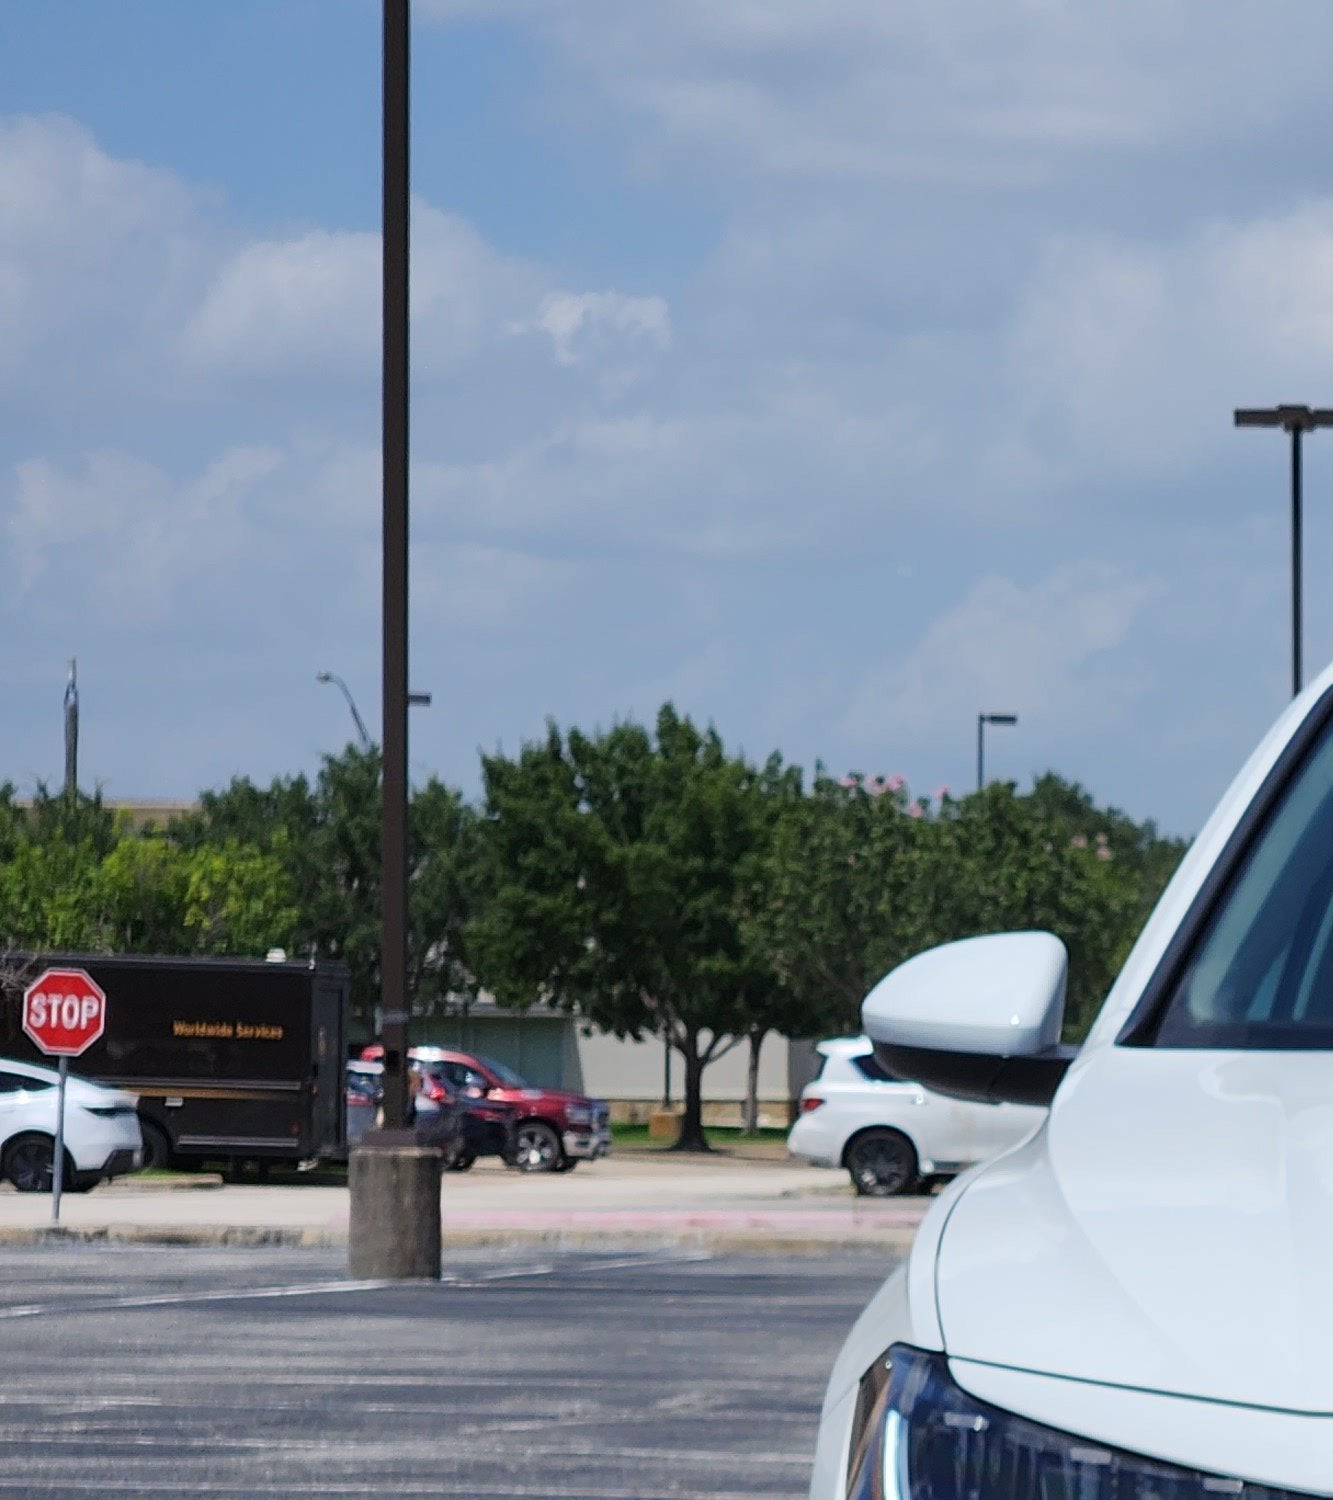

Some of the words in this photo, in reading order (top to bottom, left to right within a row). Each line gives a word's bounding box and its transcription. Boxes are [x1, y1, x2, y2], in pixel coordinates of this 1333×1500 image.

[29, 993, 99, 1030] STOP
[173, 1020, 233, 1038] Worldwide
[236, 1022, 284, 1040] Services
